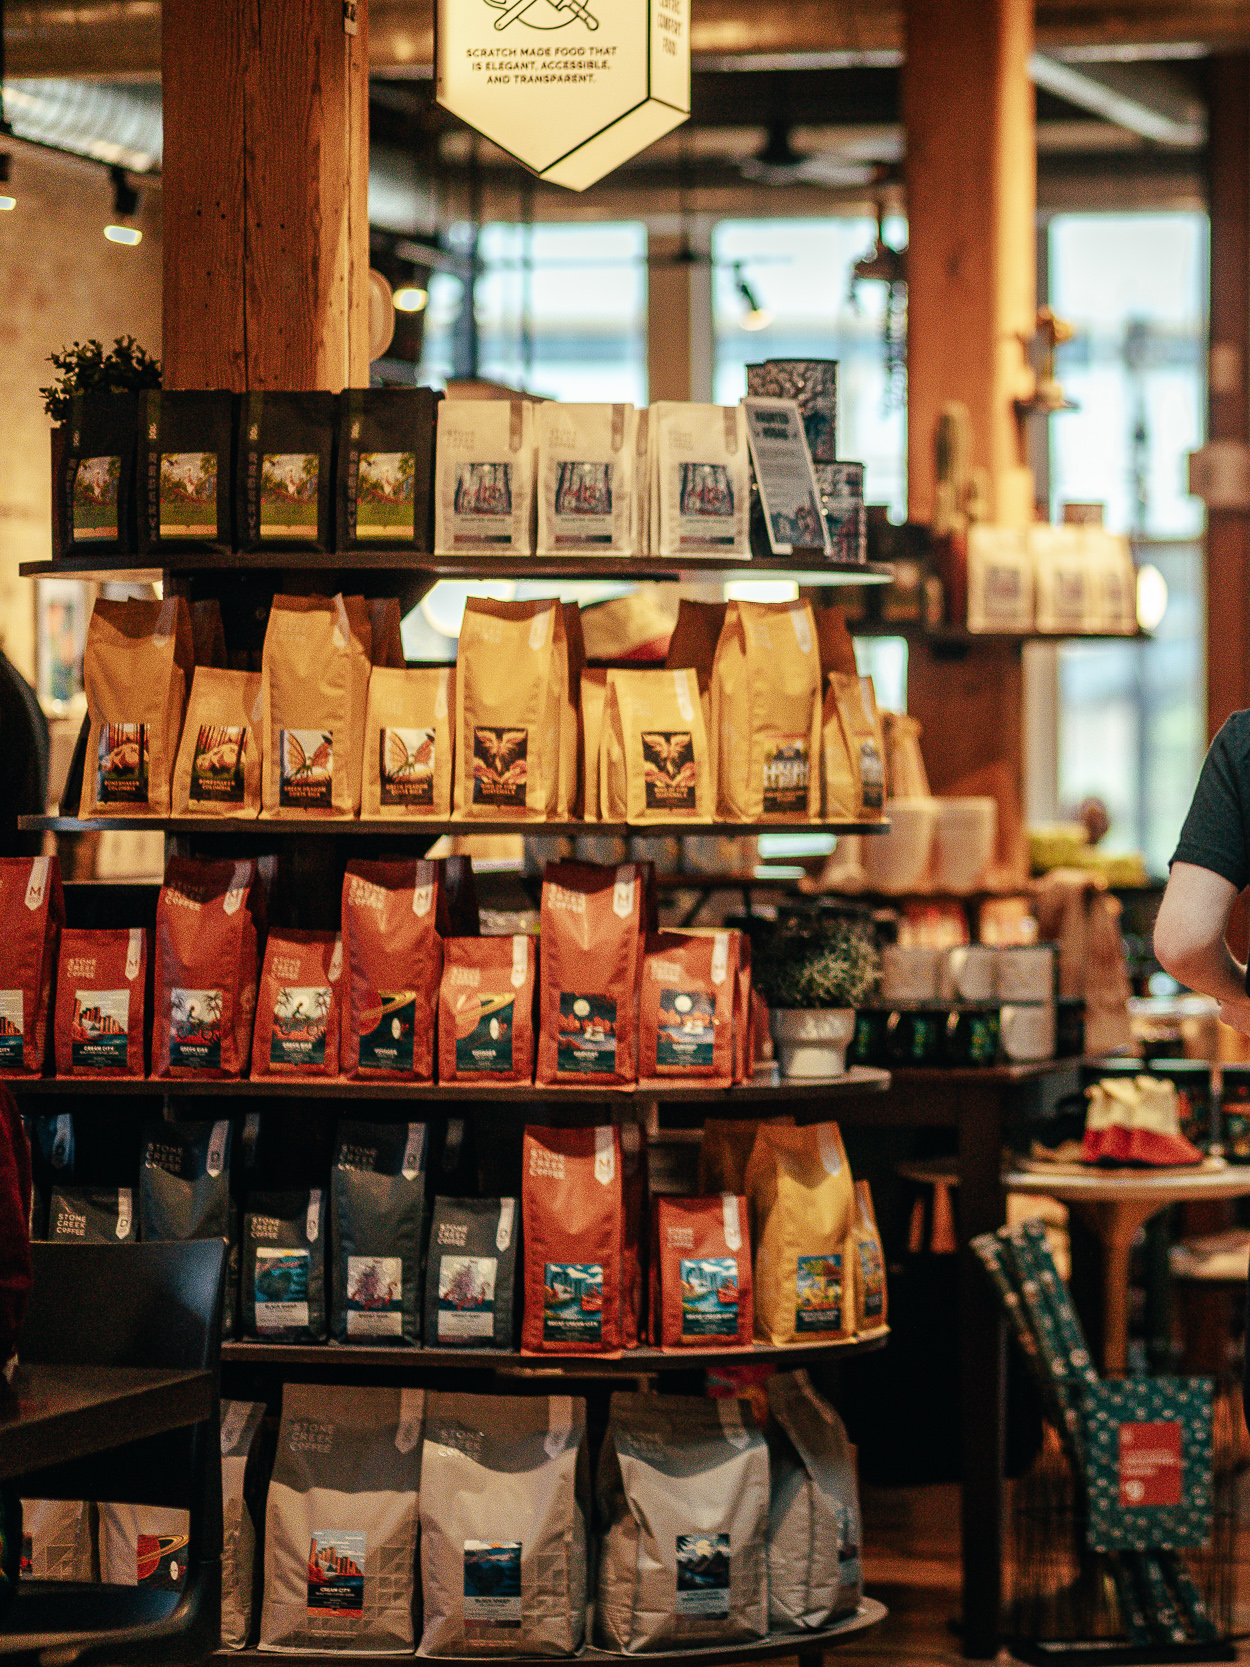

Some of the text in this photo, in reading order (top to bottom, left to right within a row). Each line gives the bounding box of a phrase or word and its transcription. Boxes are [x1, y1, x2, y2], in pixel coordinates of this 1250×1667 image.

[466, 46, 618, 58] SCRATCH MADE FOOD THAT
[472, 60, 612, 72] IS ELEGANT, ACCESSIBLE,
[486, 73, 598, 84] AND TRANSPARENT.
[30, 887, 41, 896] M
[69, 957, 97, 965] STONE
[67, 971, 96, 979] COFFEE
[148, 1143, 183, 1154] STONE
[341, 1144, 377, 1156] STONE
[146, 1151, 183, 1163] CREEK
[58, 1213, 86, 1223] STONE
[120, 1218, 128, 1228] D
[252, 1216, 280, 1226] STONE
[57, 1221, 86, 1229] CREEK
[251, 1223, 279, 1232] CREEK
[56, 1227, 85, 1236] COFFEE
[251, 1230, 278, 1239] COFFEE
[292, 1422, 335, 1435] STONE
[291, 1432, 333, 1444] CREEK
[289, 1441, 332, 1454] COFFEE
